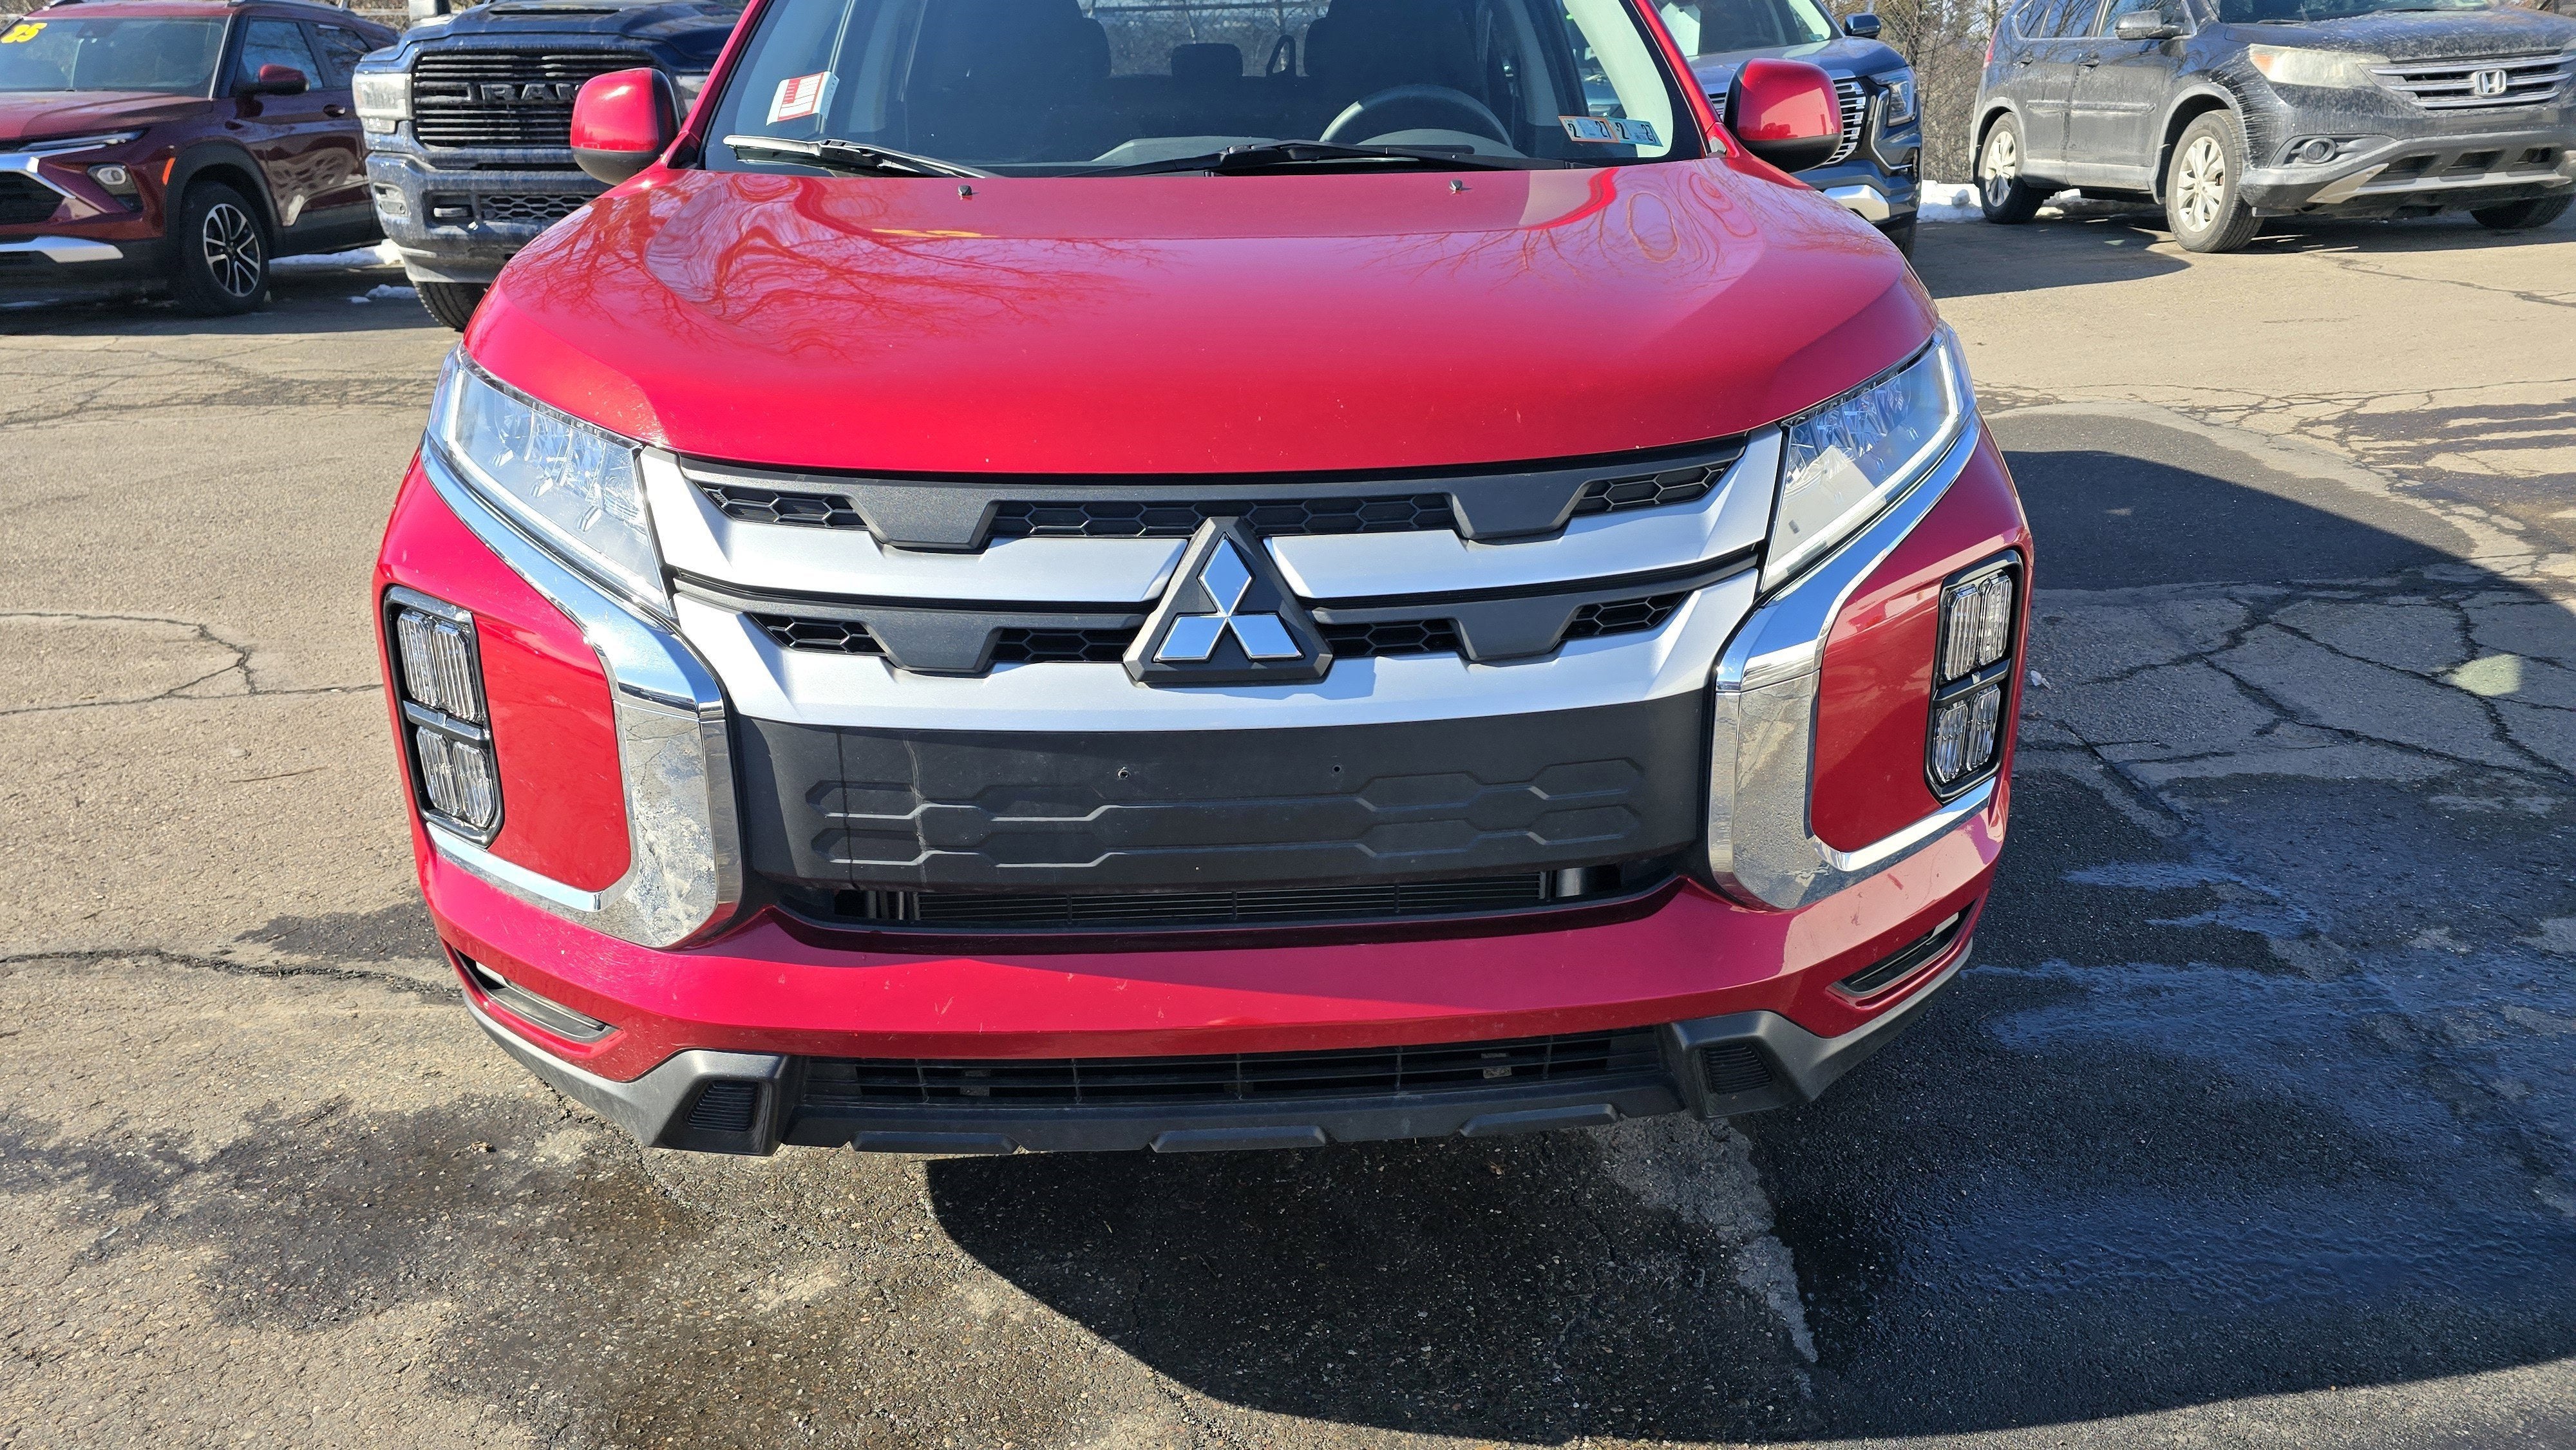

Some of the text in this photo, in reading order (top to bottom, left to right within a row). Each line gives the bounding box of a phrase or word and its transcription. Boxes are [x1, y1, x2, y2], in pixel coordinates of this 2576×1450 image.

[1567, 120, 1612, 140] 2 27
[1615, 122, 1630, 140] 2
[1640, 124, 1657, 143] 27
